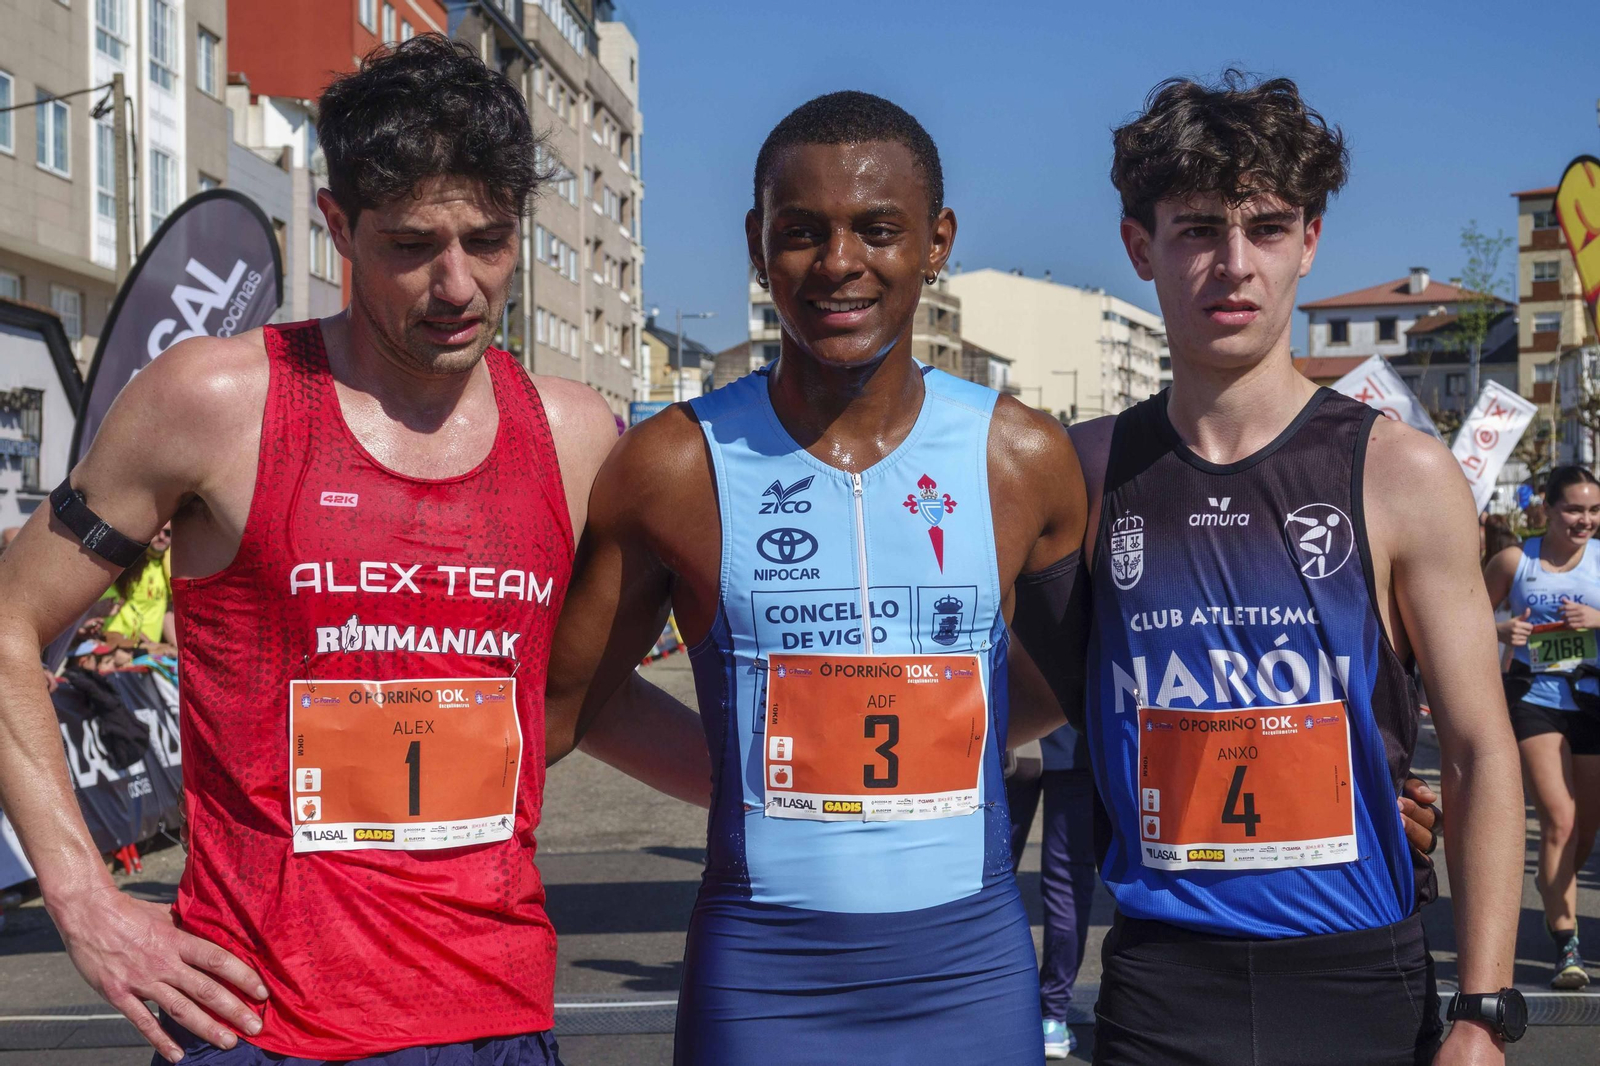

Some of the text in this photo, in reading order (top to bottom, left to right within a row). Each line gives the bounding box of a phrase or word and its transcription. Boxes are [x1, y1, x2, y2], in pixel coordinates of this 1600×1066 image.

[217, 269, 262, 338] cocinas
[130, 258, 248, 380] SAL
[322, 493, 355, 505] 42K
[758, 500, 812, 514] ZICO
[1189, 513, 1250, 526] amura
[754, 568, 821, 581] NIPOCAR
[290, 561, 553, 606] ALEX TEAM
[765, 600, 900, 624] CONCELLO
[1130, 608, 1183, 632] CLUB
[316, 624, 521, 660] RUNMANIAK
[782, 626, 888, 650] DE VIGO
[1542, 636, 1585, 662] 2168
[835, 662, 902, 678] PORRIÑO
[905, 664, 939, 677] 10K.
[1112, 633, 1350, 714] NARÓN
[365, 688, 433, 704] PORRIÑO
[436, 689, 470, 703] 10K.
[867, 695, 896, 708] ADF
[393, 720, 435, 735] ALEX
[1192, 716, 1256, 733] PORRIÑO
[1260, 716, 1298, 730] 10K.
[863, 714, 899, 789] 3
[1217, 746, 1258, 761] ANXO
[404, 740, 421, 816] 1
[783, 797, 817, 810] LASAL
[824, 801, 861, 812] GADIS
[1221, 765, 1261, 837] 4
[314, 830, 347, 841] LASAL
[355, 829, 394, 840] GADIS
[1153, 848, 1182, 861] LASAL
[1188, 850, 1224, 860] GADIS
